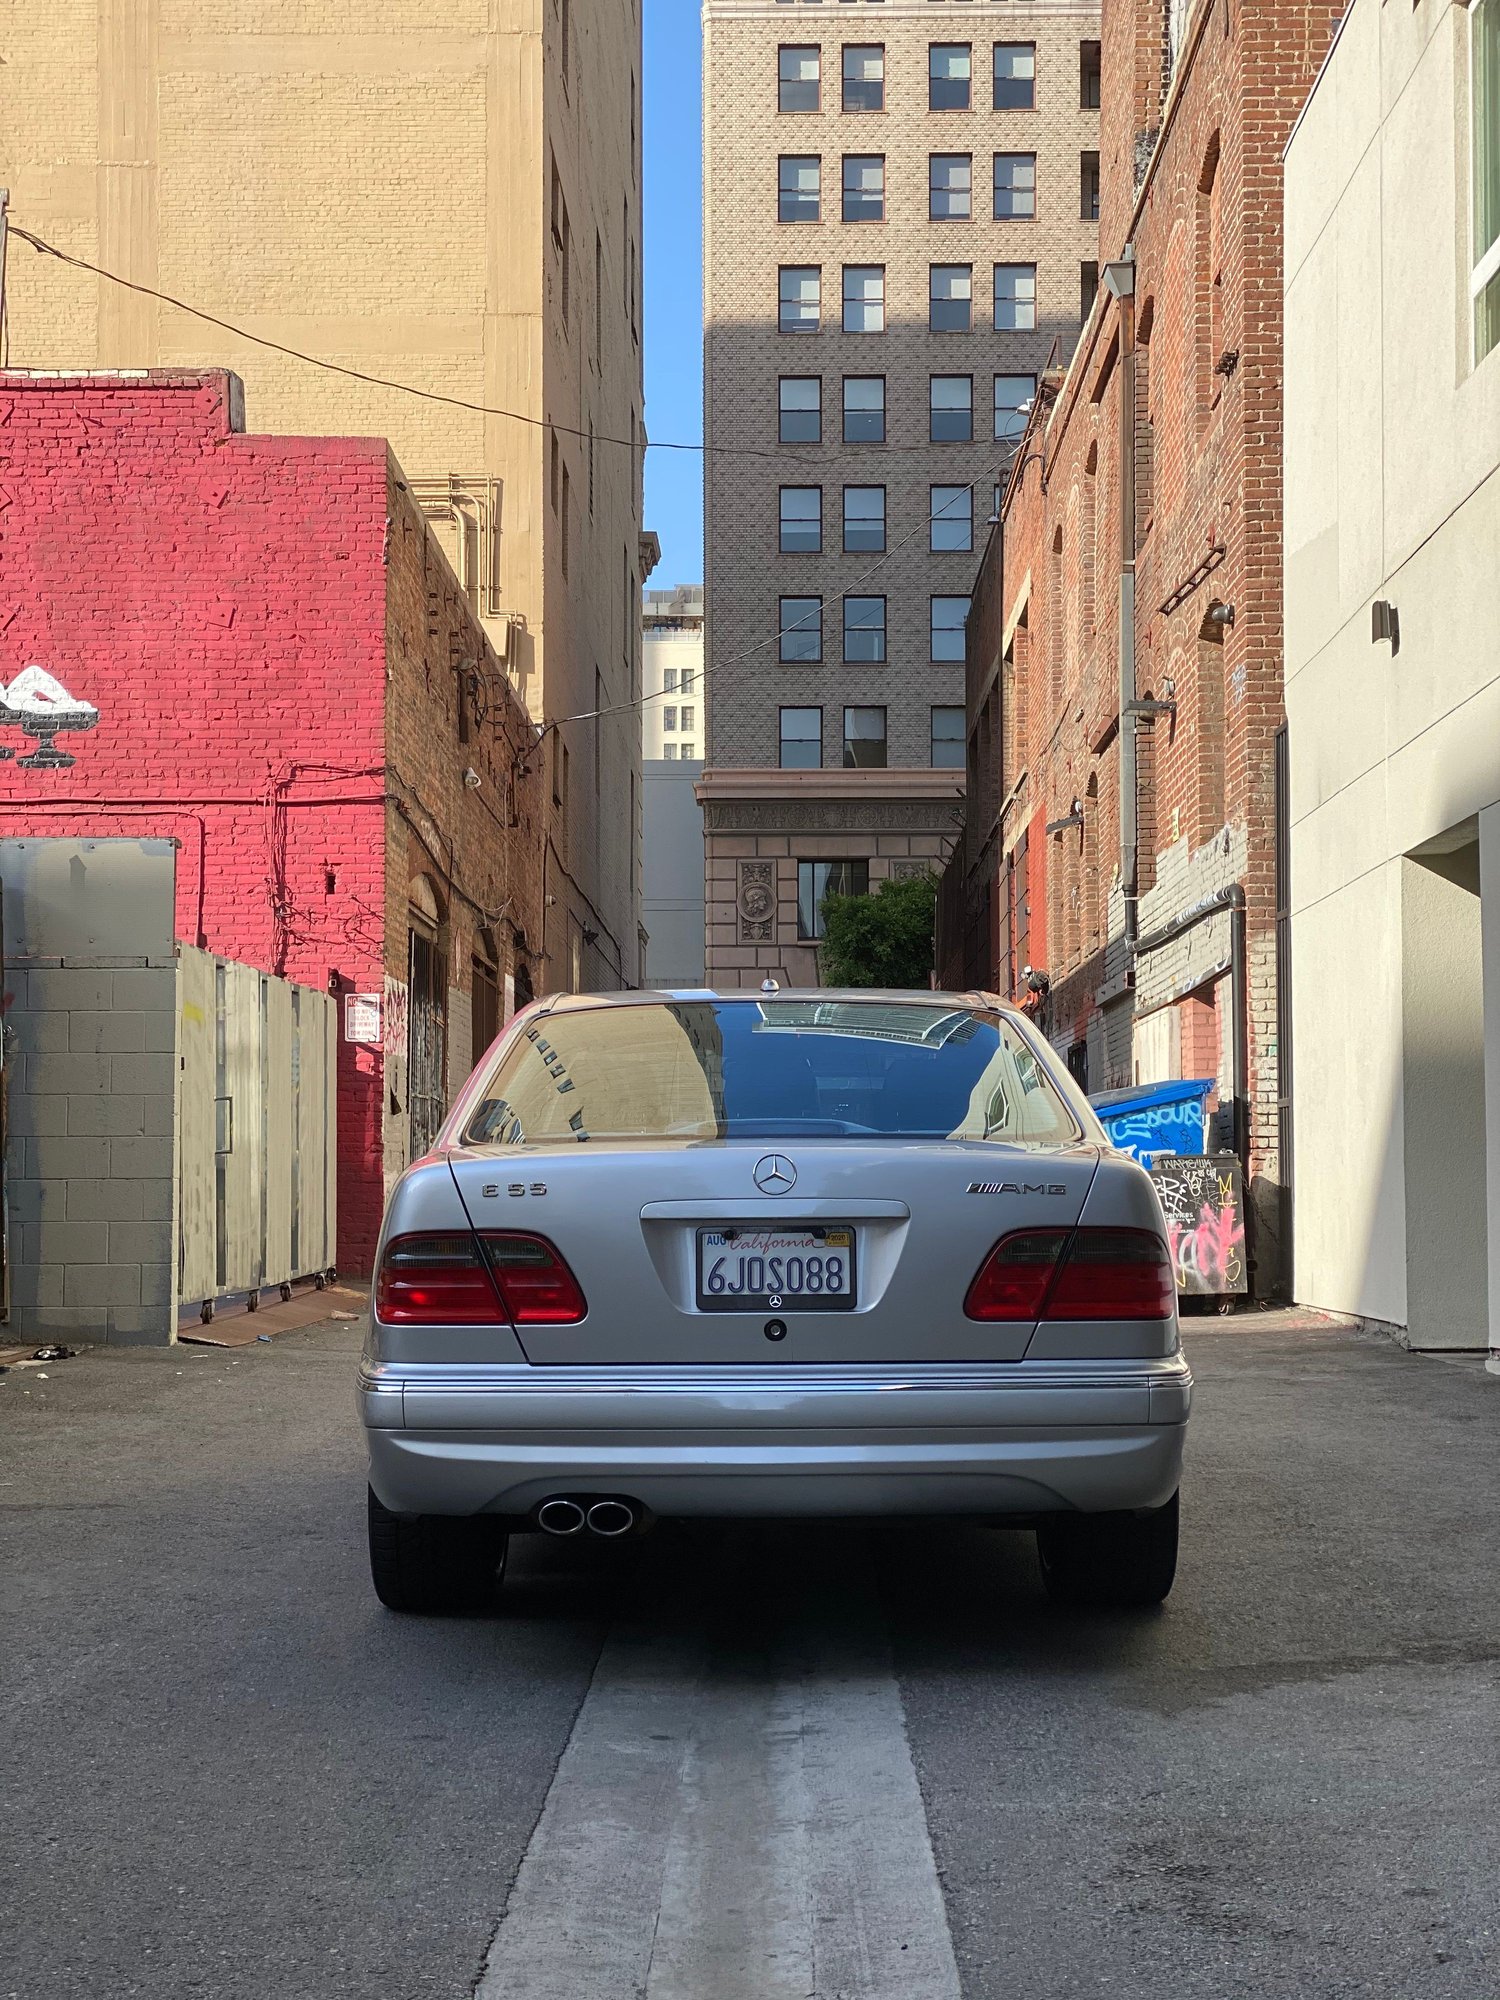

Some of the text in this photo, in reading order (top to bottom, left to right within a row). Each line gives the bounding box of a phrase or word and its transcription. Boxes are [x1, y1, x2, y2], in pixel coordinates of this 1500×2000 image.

[997, 1183, 1066, 1195] AMG
[1164, 1211, 1194, 1219] Services
[706, 1235, 727, 1246] AUG
[729, 1231, 825, 1255] California
